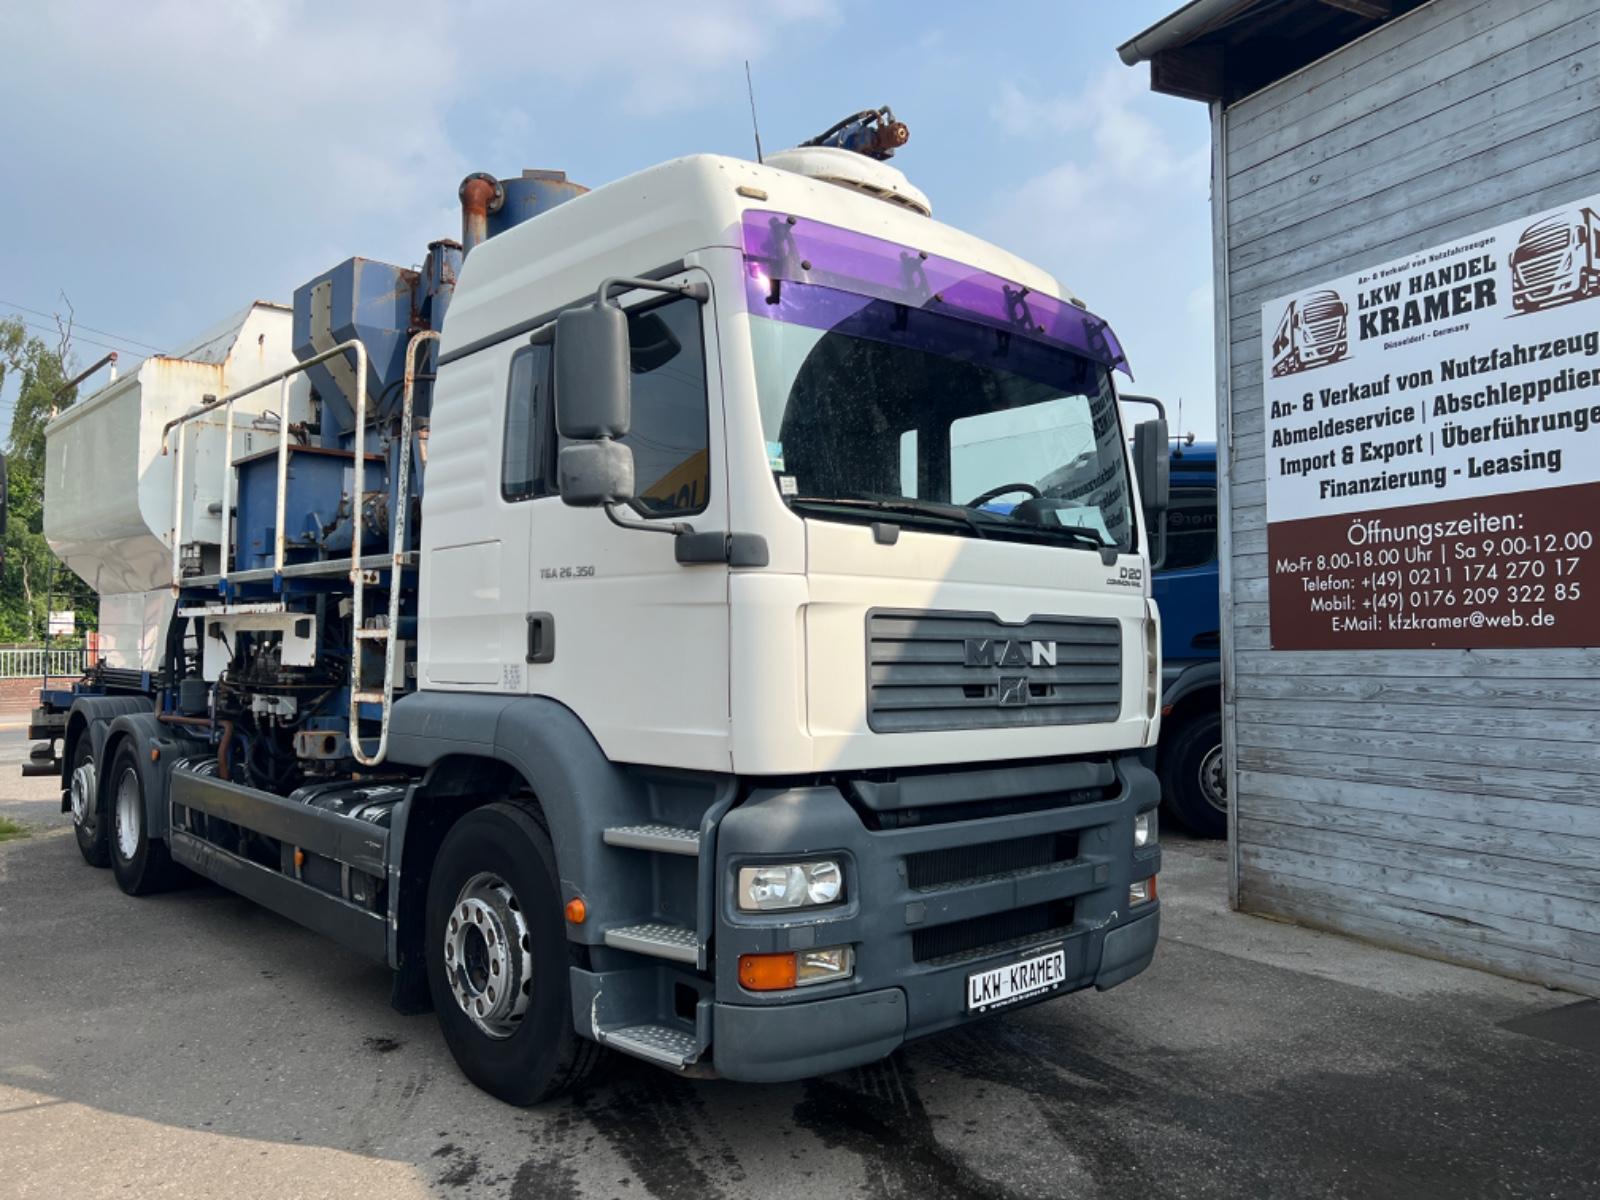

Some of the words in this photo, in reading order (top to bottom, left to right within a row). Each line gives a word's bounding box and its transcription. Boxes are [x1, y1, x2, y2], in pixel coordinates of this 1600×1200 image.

[1358, 282, 1402, 310] LKW
[1408, 254, 1497, 295] HANDEL
[1359, 277, 1497, 341] KRAMER
[1271, 400, 1297, 419] An-
[1302, 392, 1314, 412] &
[1320, 374, 1390, 408] Verkauf
[1397, 369, 1433, 391] von
[1272, 406, 1415, 448] Abmeldeservice
[1280, 449, 1336, 476] Import
[1342, 445, 1354, 465] &
[1360, 433, 1423, 464] Export
[1320, 466, 1447, 499] Finanzierung
[1468, 448, 1561, 478] Leasing
[1347, 512, 1524, 546] Öffnungszeiten:
[1276, 556, 1313, 574] Mo-Fr
[1317, 549, 1400, 571] 8.00-18.00
[1404, 545, 1433, 563] Uhr
[1455, 542, 1476, 559] Sa
[1482, 530, 1593, 557] 9.00-12.00
[1301, 574, 1355, 592] Telefon:
[1361, 571, 1402, 591] +(49)
[1409, 566, 1452, 585] 0211
[1464, 563, 1498, 582] 174
[1506, 560, 1545, 580] 270
[1555, 557, 1580, 576] 17
[1310, 594, 1356, 612] Mobil:
[1362, 592, 1403, 612] +(49)
[1410, 590, 1456, 608] 0176
[1463, 587, 1499, 605] 209
[1507, 584, 1545, 603] 322
[1554, 582, 1580, 601] 85
[1332, 615, 1382, 632] E-Mail:
[1388, 608, 1556, 630] kfzkramer@web.de
[964, 639, 1057, 666] MAN
